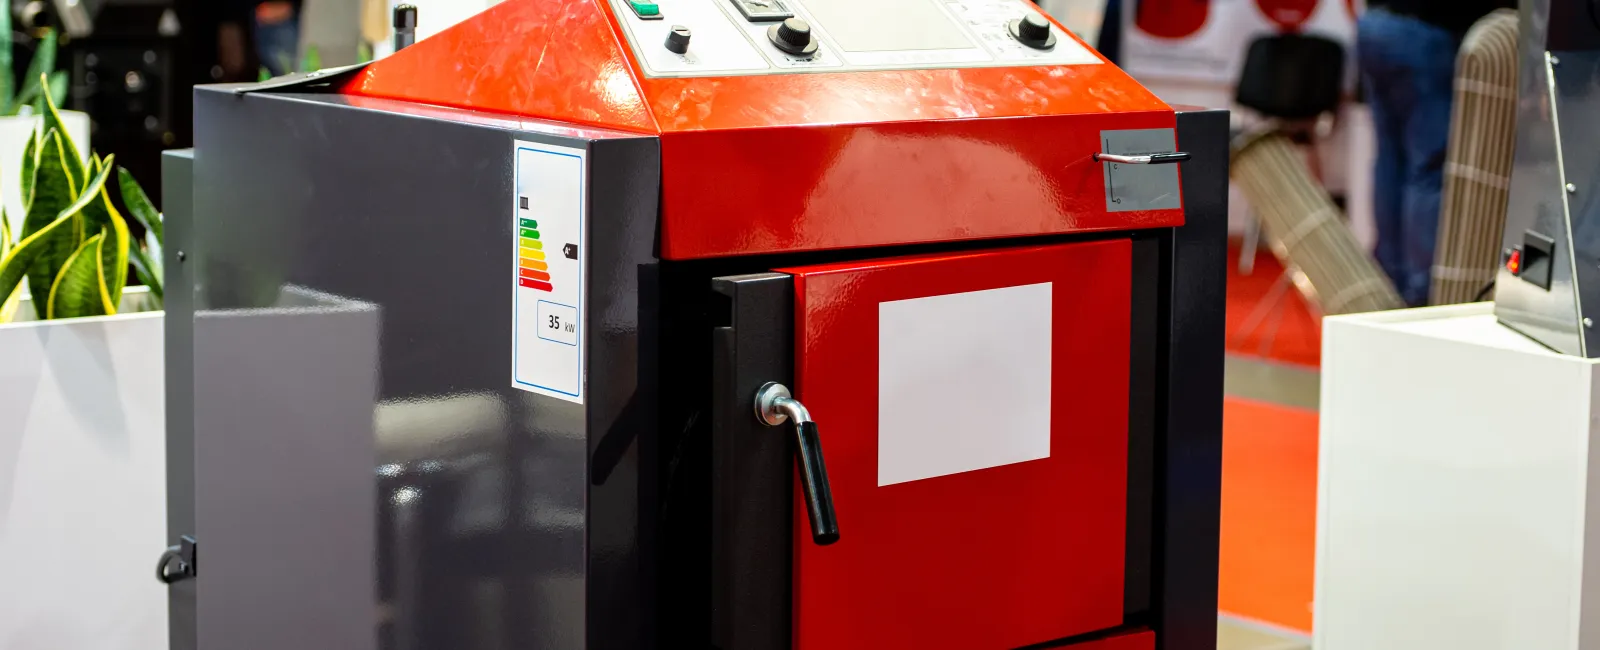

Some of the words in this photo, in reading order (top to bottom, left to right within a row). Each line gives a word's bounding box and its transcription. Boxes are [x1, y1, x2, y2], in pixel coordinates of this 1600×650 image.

[564, 246, 571, 255] A+
[548, 314, 560, 330] 35
[564, 322, 576, 333] kW
